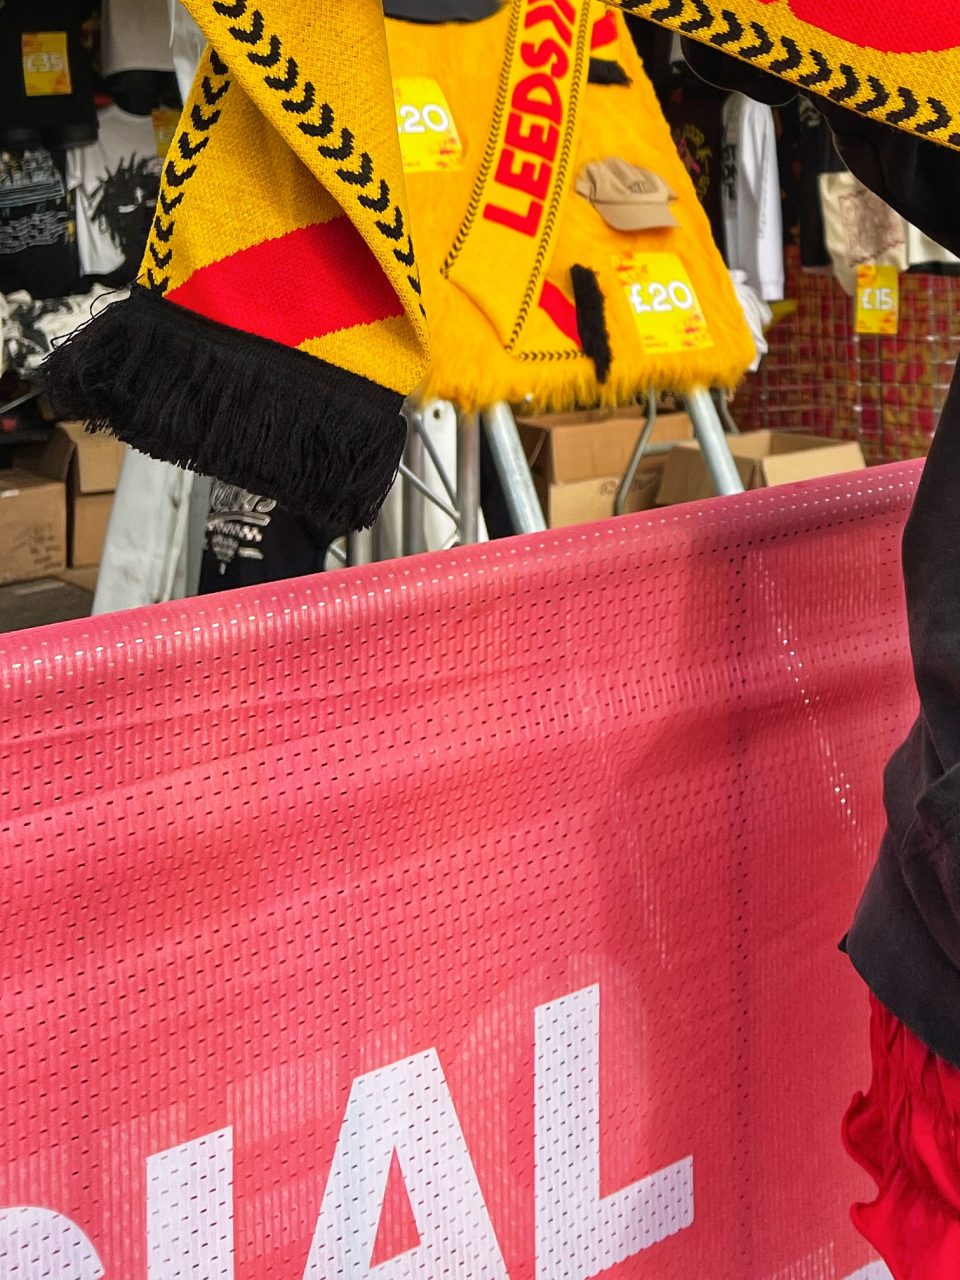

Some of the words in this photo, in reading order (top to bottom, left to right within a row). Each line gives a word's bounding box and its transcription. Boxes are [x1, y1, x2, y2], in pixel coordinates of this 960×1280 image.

[398, 103, 449, 133] 20
[483, 35, 570, 238] LEEDS
[630, 280, 693, 313] £20
[861, 287, 894, 311] £15
[0, 982, 694, 1280] IAL
